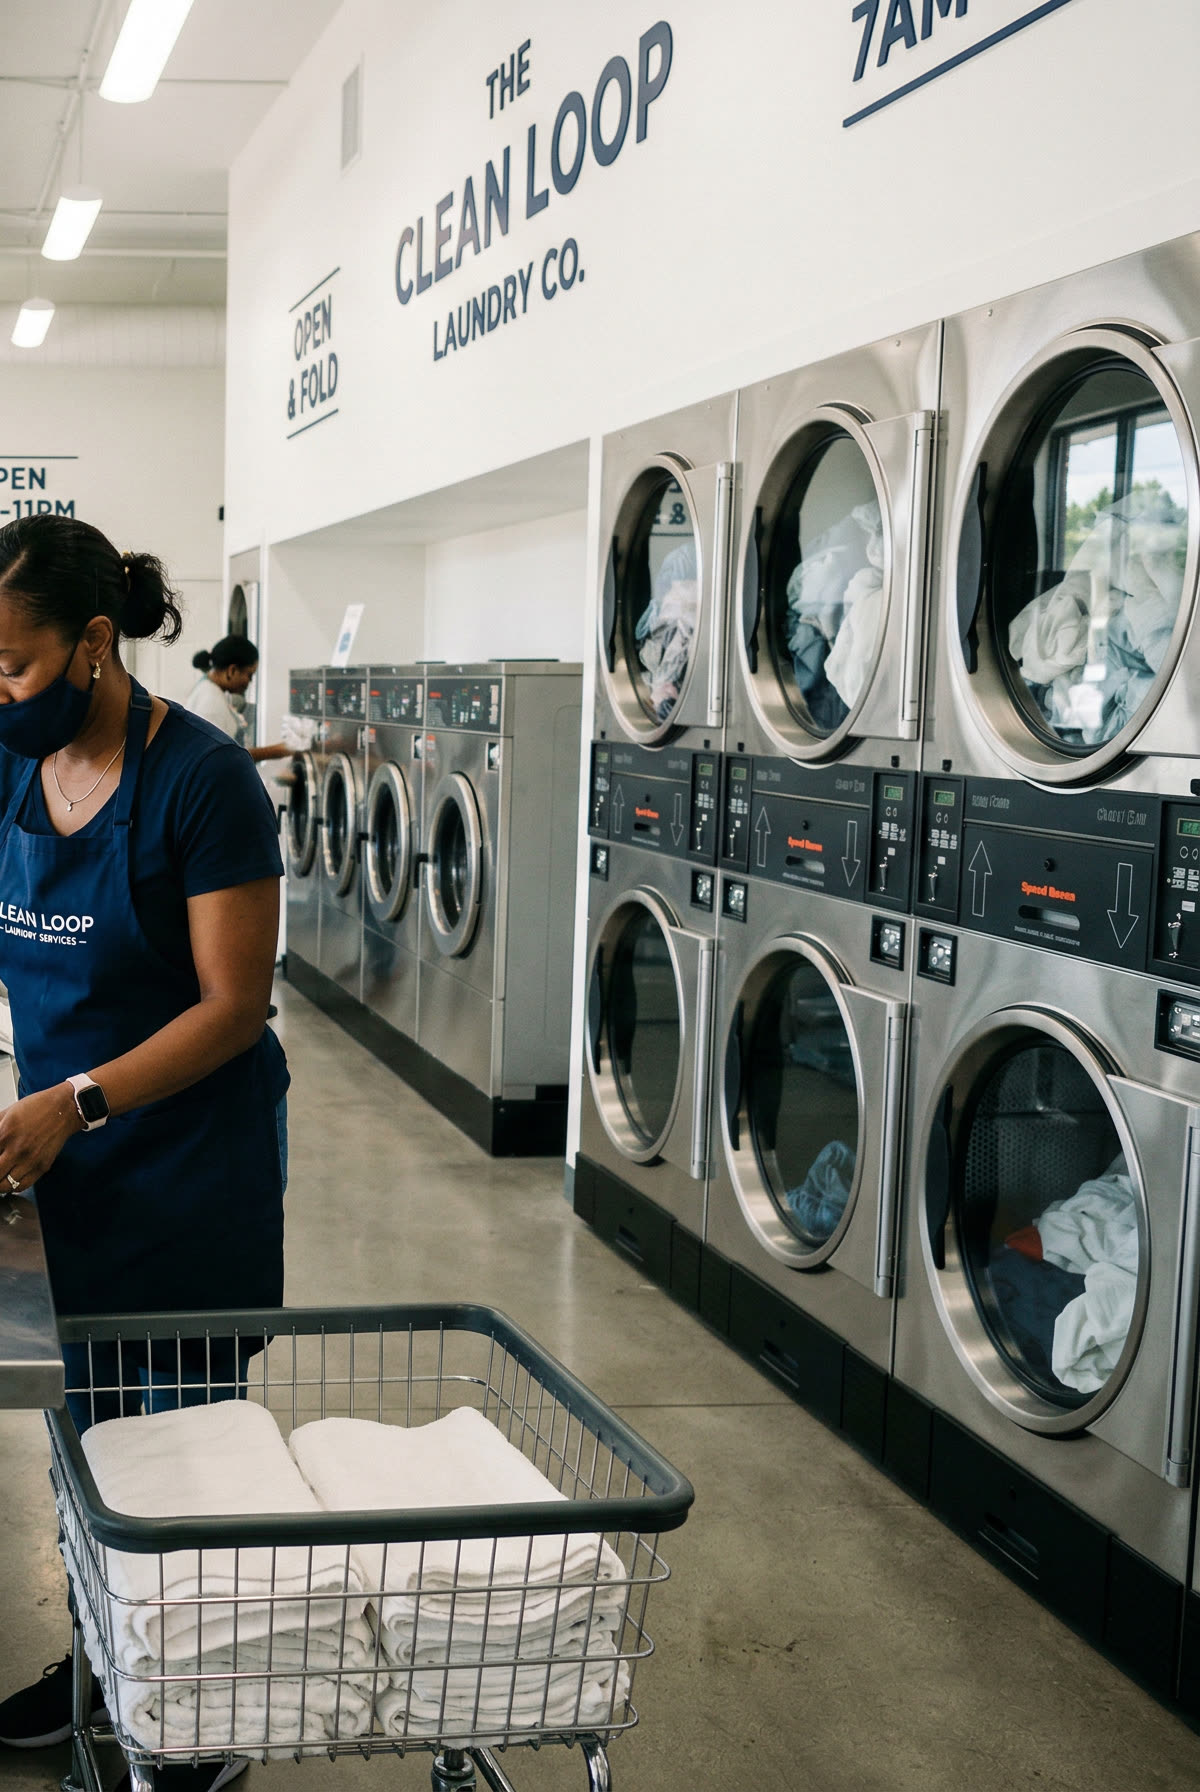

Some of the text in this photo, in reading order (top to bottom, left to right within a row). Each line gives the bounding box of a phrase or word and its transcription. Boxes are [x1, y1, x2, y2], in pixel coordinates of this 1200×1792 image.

[486, 38, 531, 119] THE
[395, 20, 673, 305] CLEAN LOOP
[294, 293, 332, 361] OPEN
[433, 237, 585, 362] LAUNDRY CO.
[287, 352, 338, 420] & FOLD
[41, 913, 94, 932] LOOP
